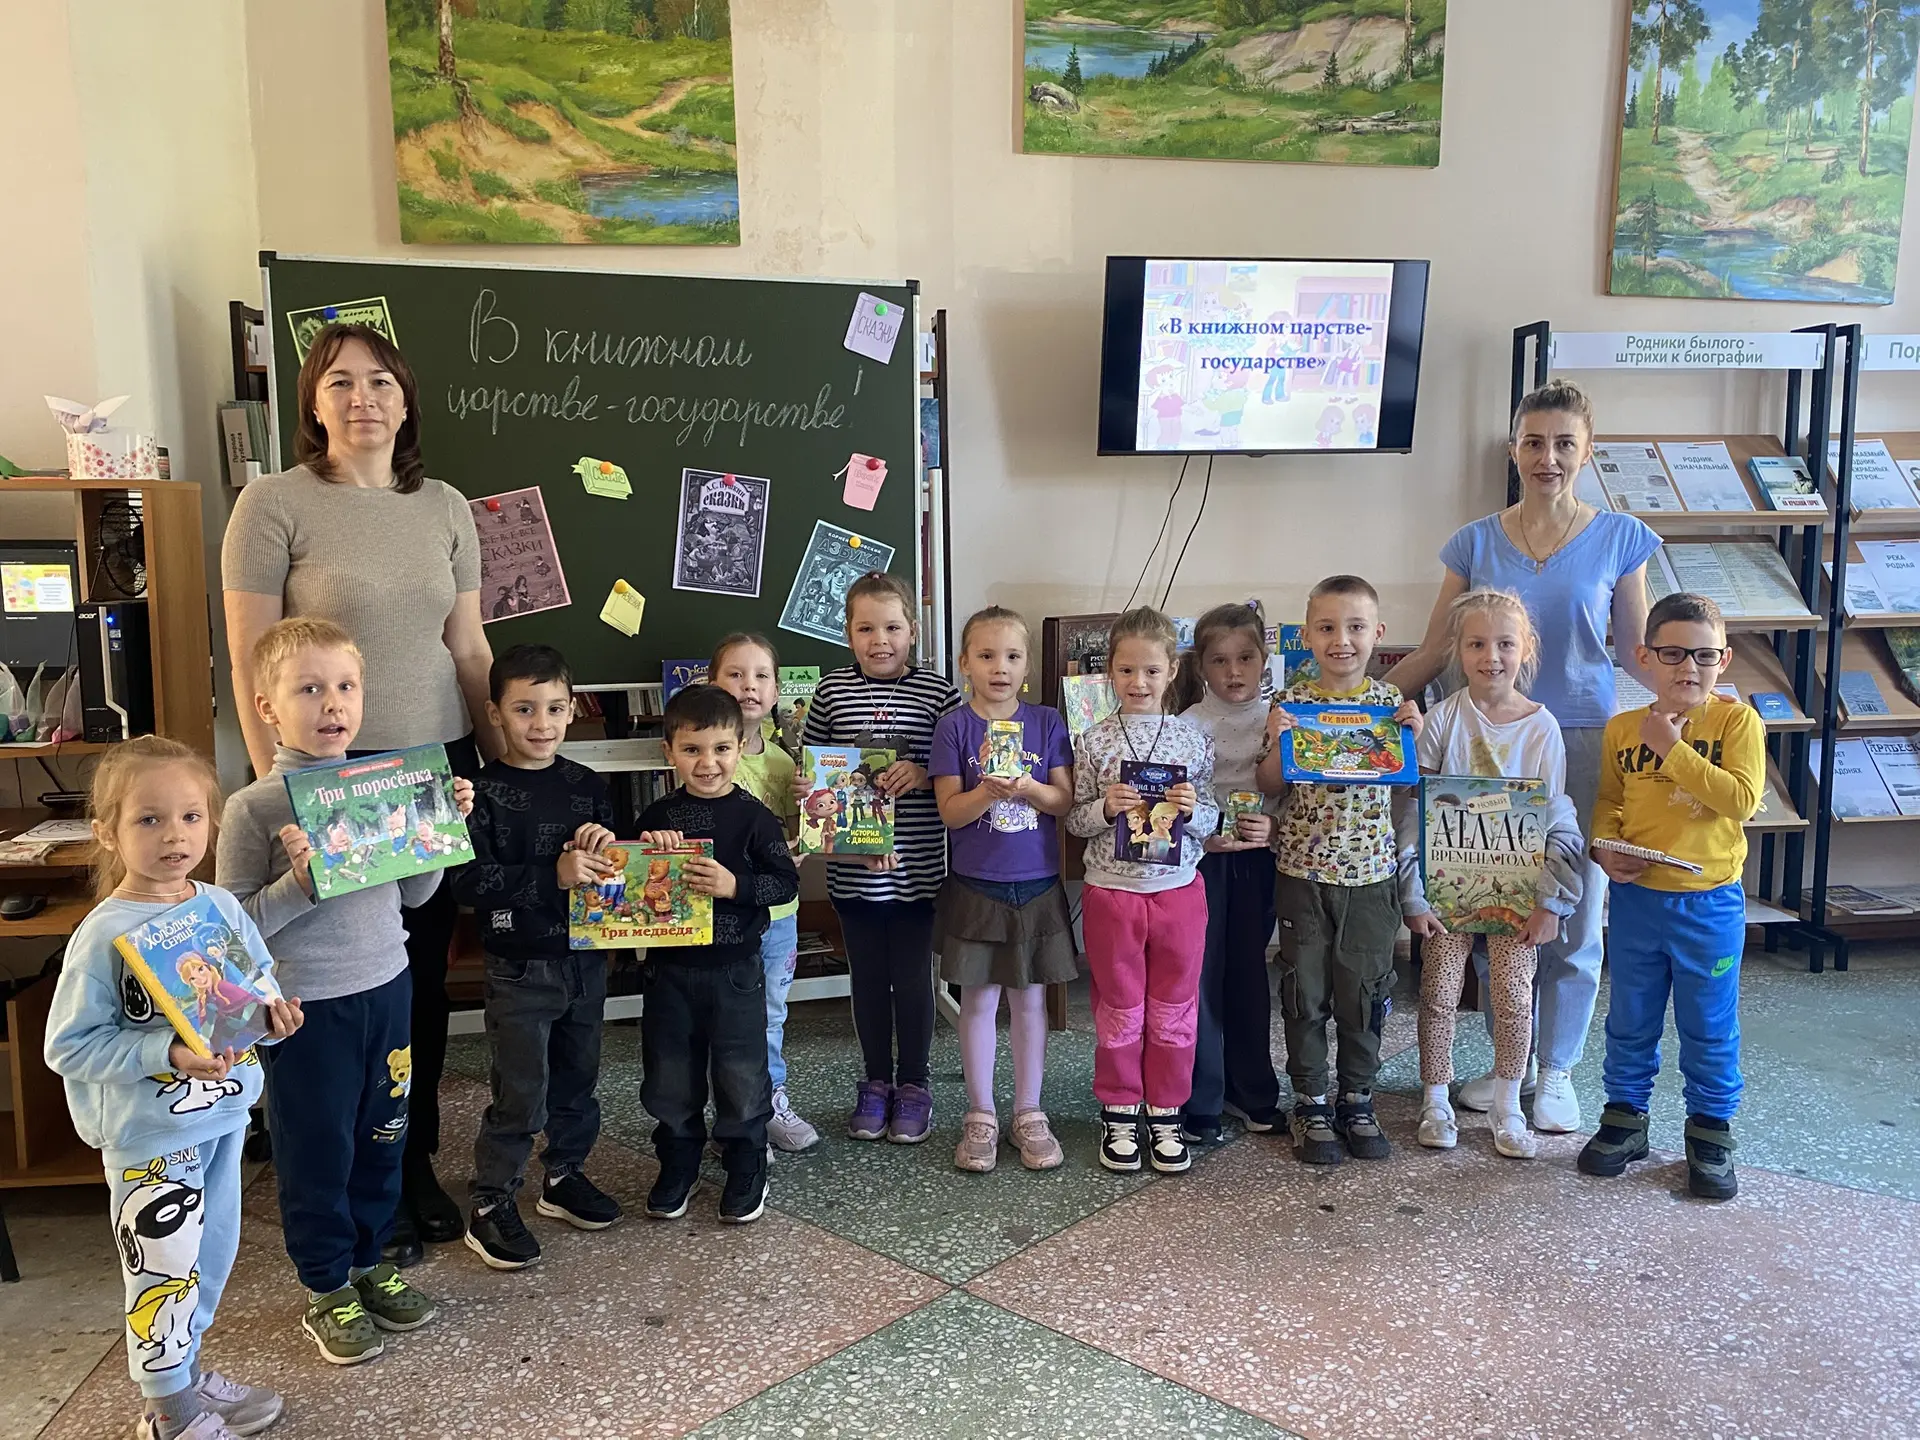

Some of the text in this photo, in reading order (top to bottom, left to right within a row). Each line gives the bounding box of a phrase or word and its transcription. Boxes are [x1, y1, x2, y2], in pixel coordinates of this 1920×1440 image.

[470, 286, 753, 367] В книжном
[857, 315, 897, 345] СКАЗКИ
[1158, 318, 1373, 343] «В книжном царстве-
[1626, 336, 1686, 351] Родники
[1690, 335, 1745, 349] былого
[1200, 356, 1327, 374] государстве»
[1615, 350, 1763, 366] штрихи к биографии
[1674, 463, 1730, 471] ИЗНАЧАЛЬНЫЙ
[828, 532, 850, 544] КОРНЕ
[480, 540, 544, 562] СКАЗКИ
[817, 538, 881, 569] АЗБУКА
[78, 612, 97, 620] acer
[1617, 739, 1722, 773] EXPRE
[1834, 767, 1862, 775] АДОНЯХ
[314, 784, 346, 808] Три
[351, 768, 434, 798] поросёнка
[1477, 797, 1507, 810] НОВЫЙ
[1432, 809, 1538, 853] АТЛАС
[851, 836, 884, 845] ДВОЙКОЙ
[1431, 849, 1496, 866] ВРЕМЕНА
[145, 910, 202, 950] ХОЛОДНОЕ
[162, 926, 197, 950] СЕРДЦЕ
[600, 926, 693, 941] Три медведя
[1716, 954, 1735, 970] NIKE
